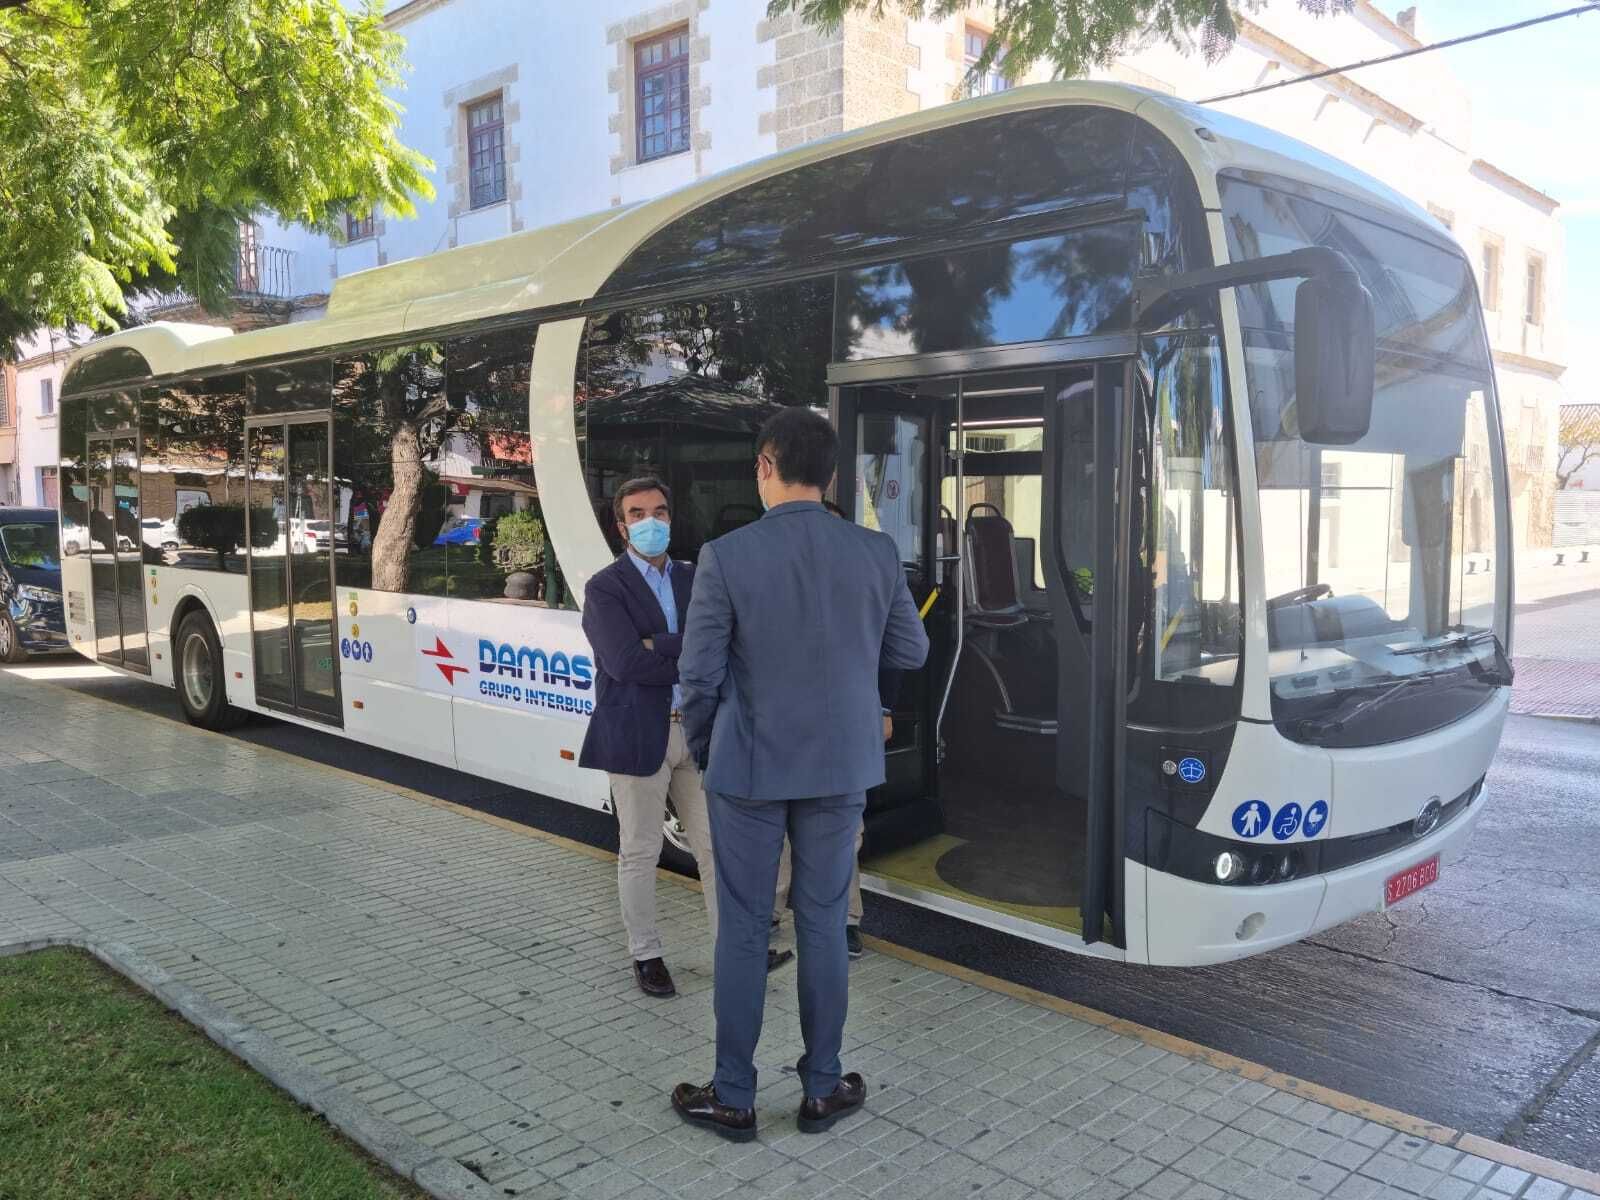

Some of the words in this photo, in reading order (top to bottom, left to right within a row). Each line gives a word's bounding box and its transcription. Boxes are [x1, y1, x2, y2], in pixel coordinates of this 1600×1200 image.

[479, 639, 593, 691] DAMAS
[480, 680, 521, 702] GRUPO
[525, 688, 593, 716] INTERBUS
[1395, 871, 1418, 897] 2706
